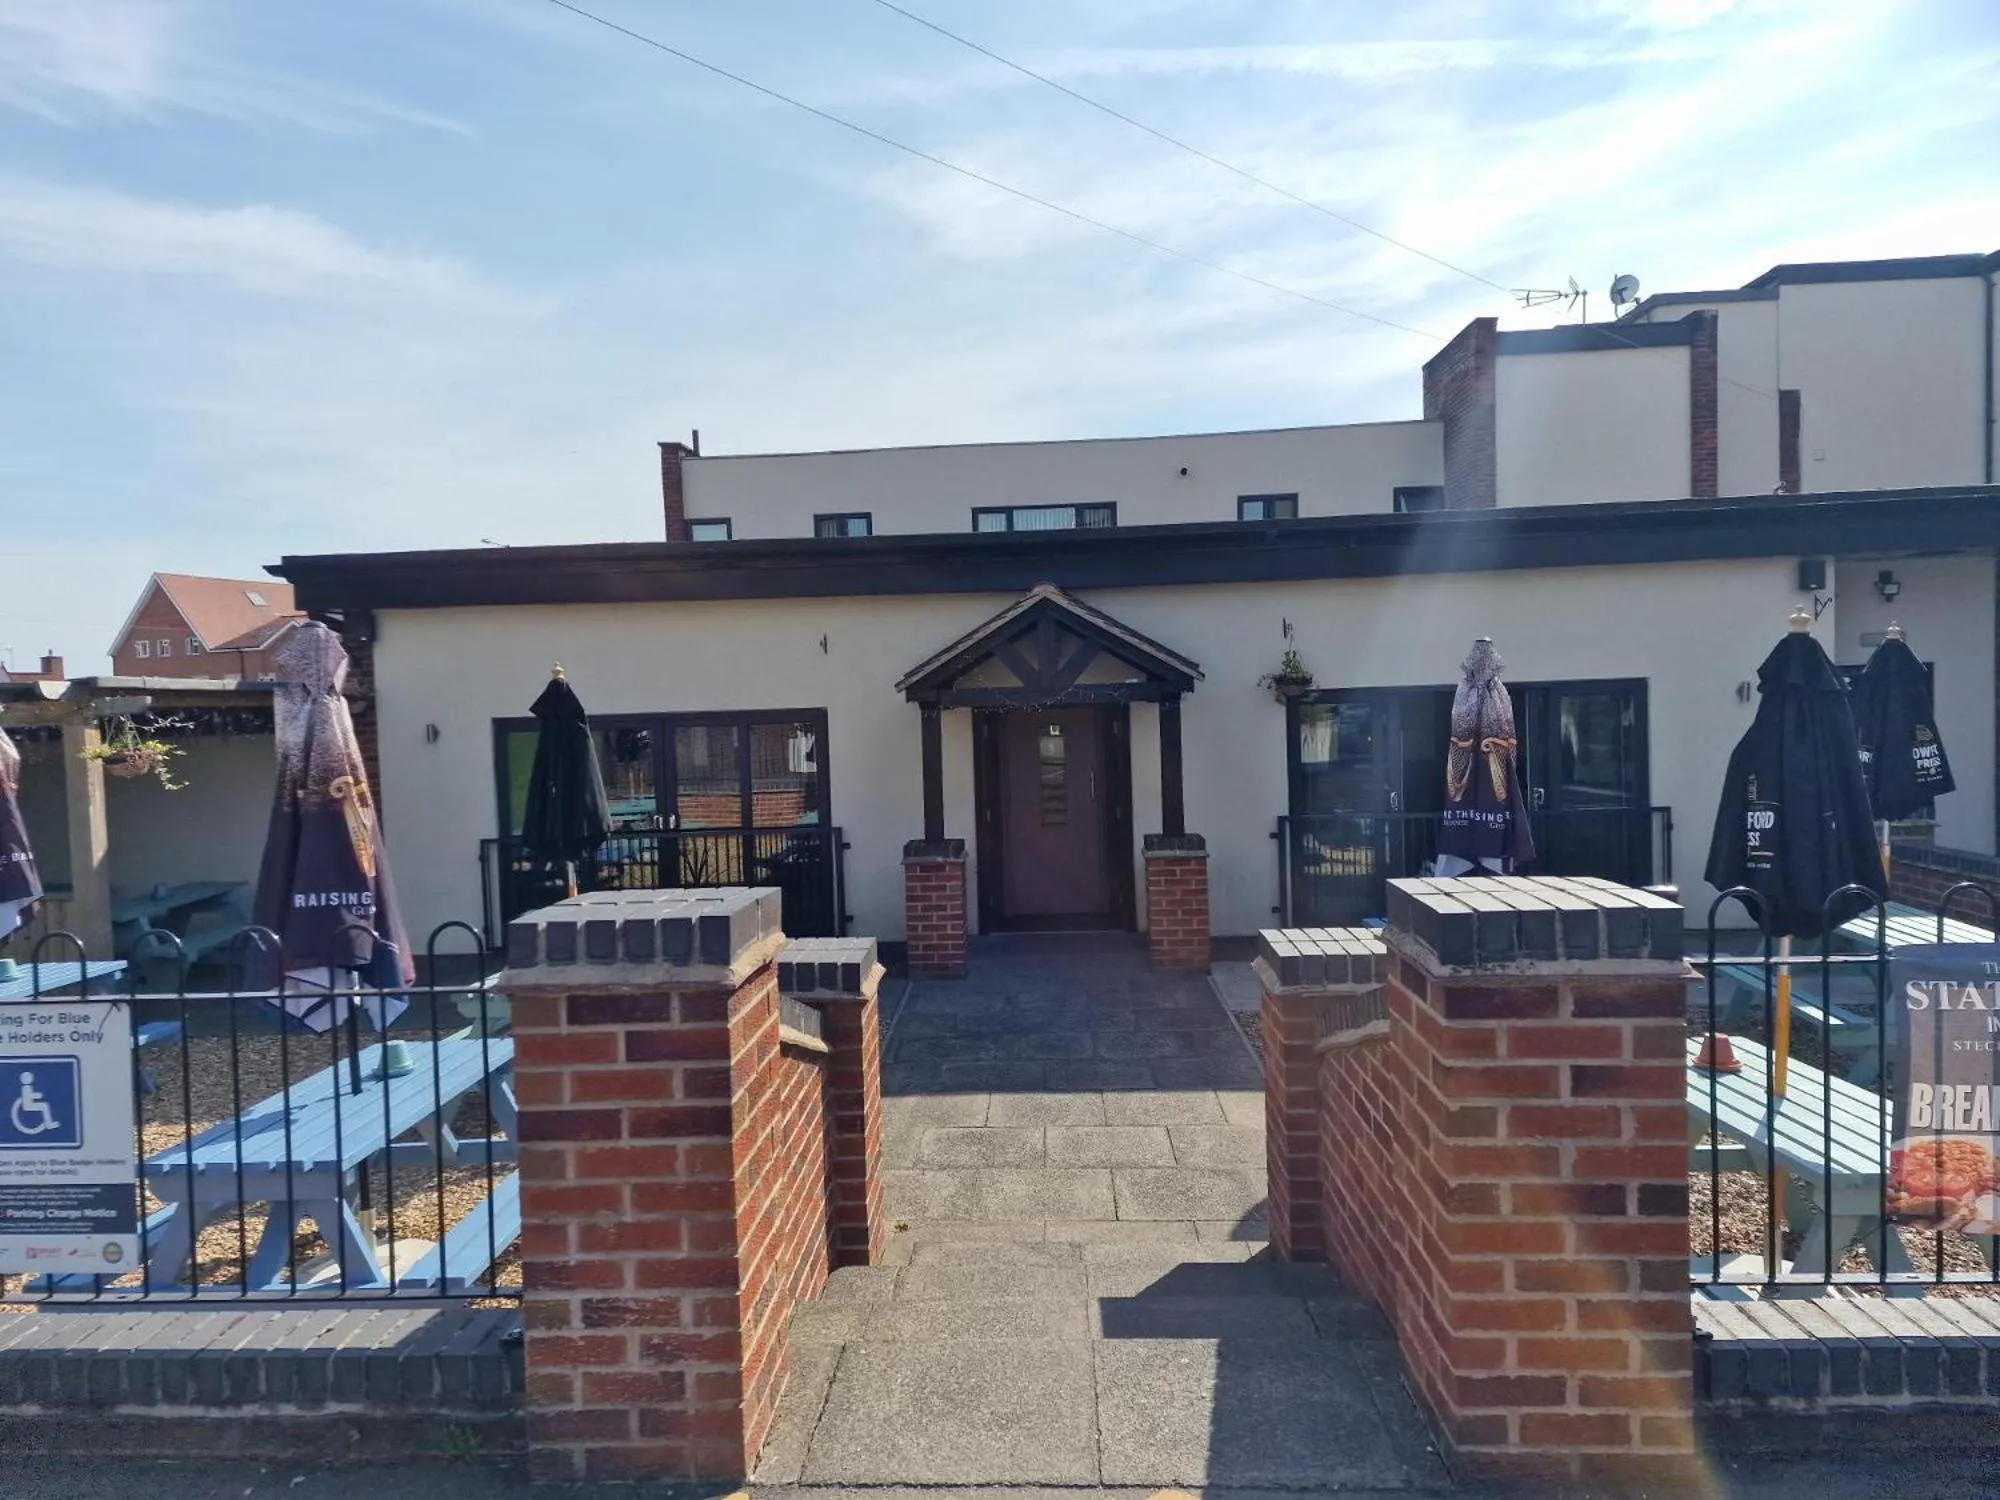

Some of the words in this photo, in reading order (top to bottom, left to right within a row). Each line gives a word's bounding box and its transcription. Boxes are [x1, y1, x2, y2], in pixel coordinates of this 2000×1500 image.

[294, 891, 373, 908] RAISING
[0, 1012, 23, 1027] ing
[28, 1013, 53, 1025] For
[58, 1011, 91, 1024] Blue
[8, 1031, 64, 1044] Holders
[69, 1029, 104, 1044] Only
[1953, 1040, 2000, 1051] STEC
